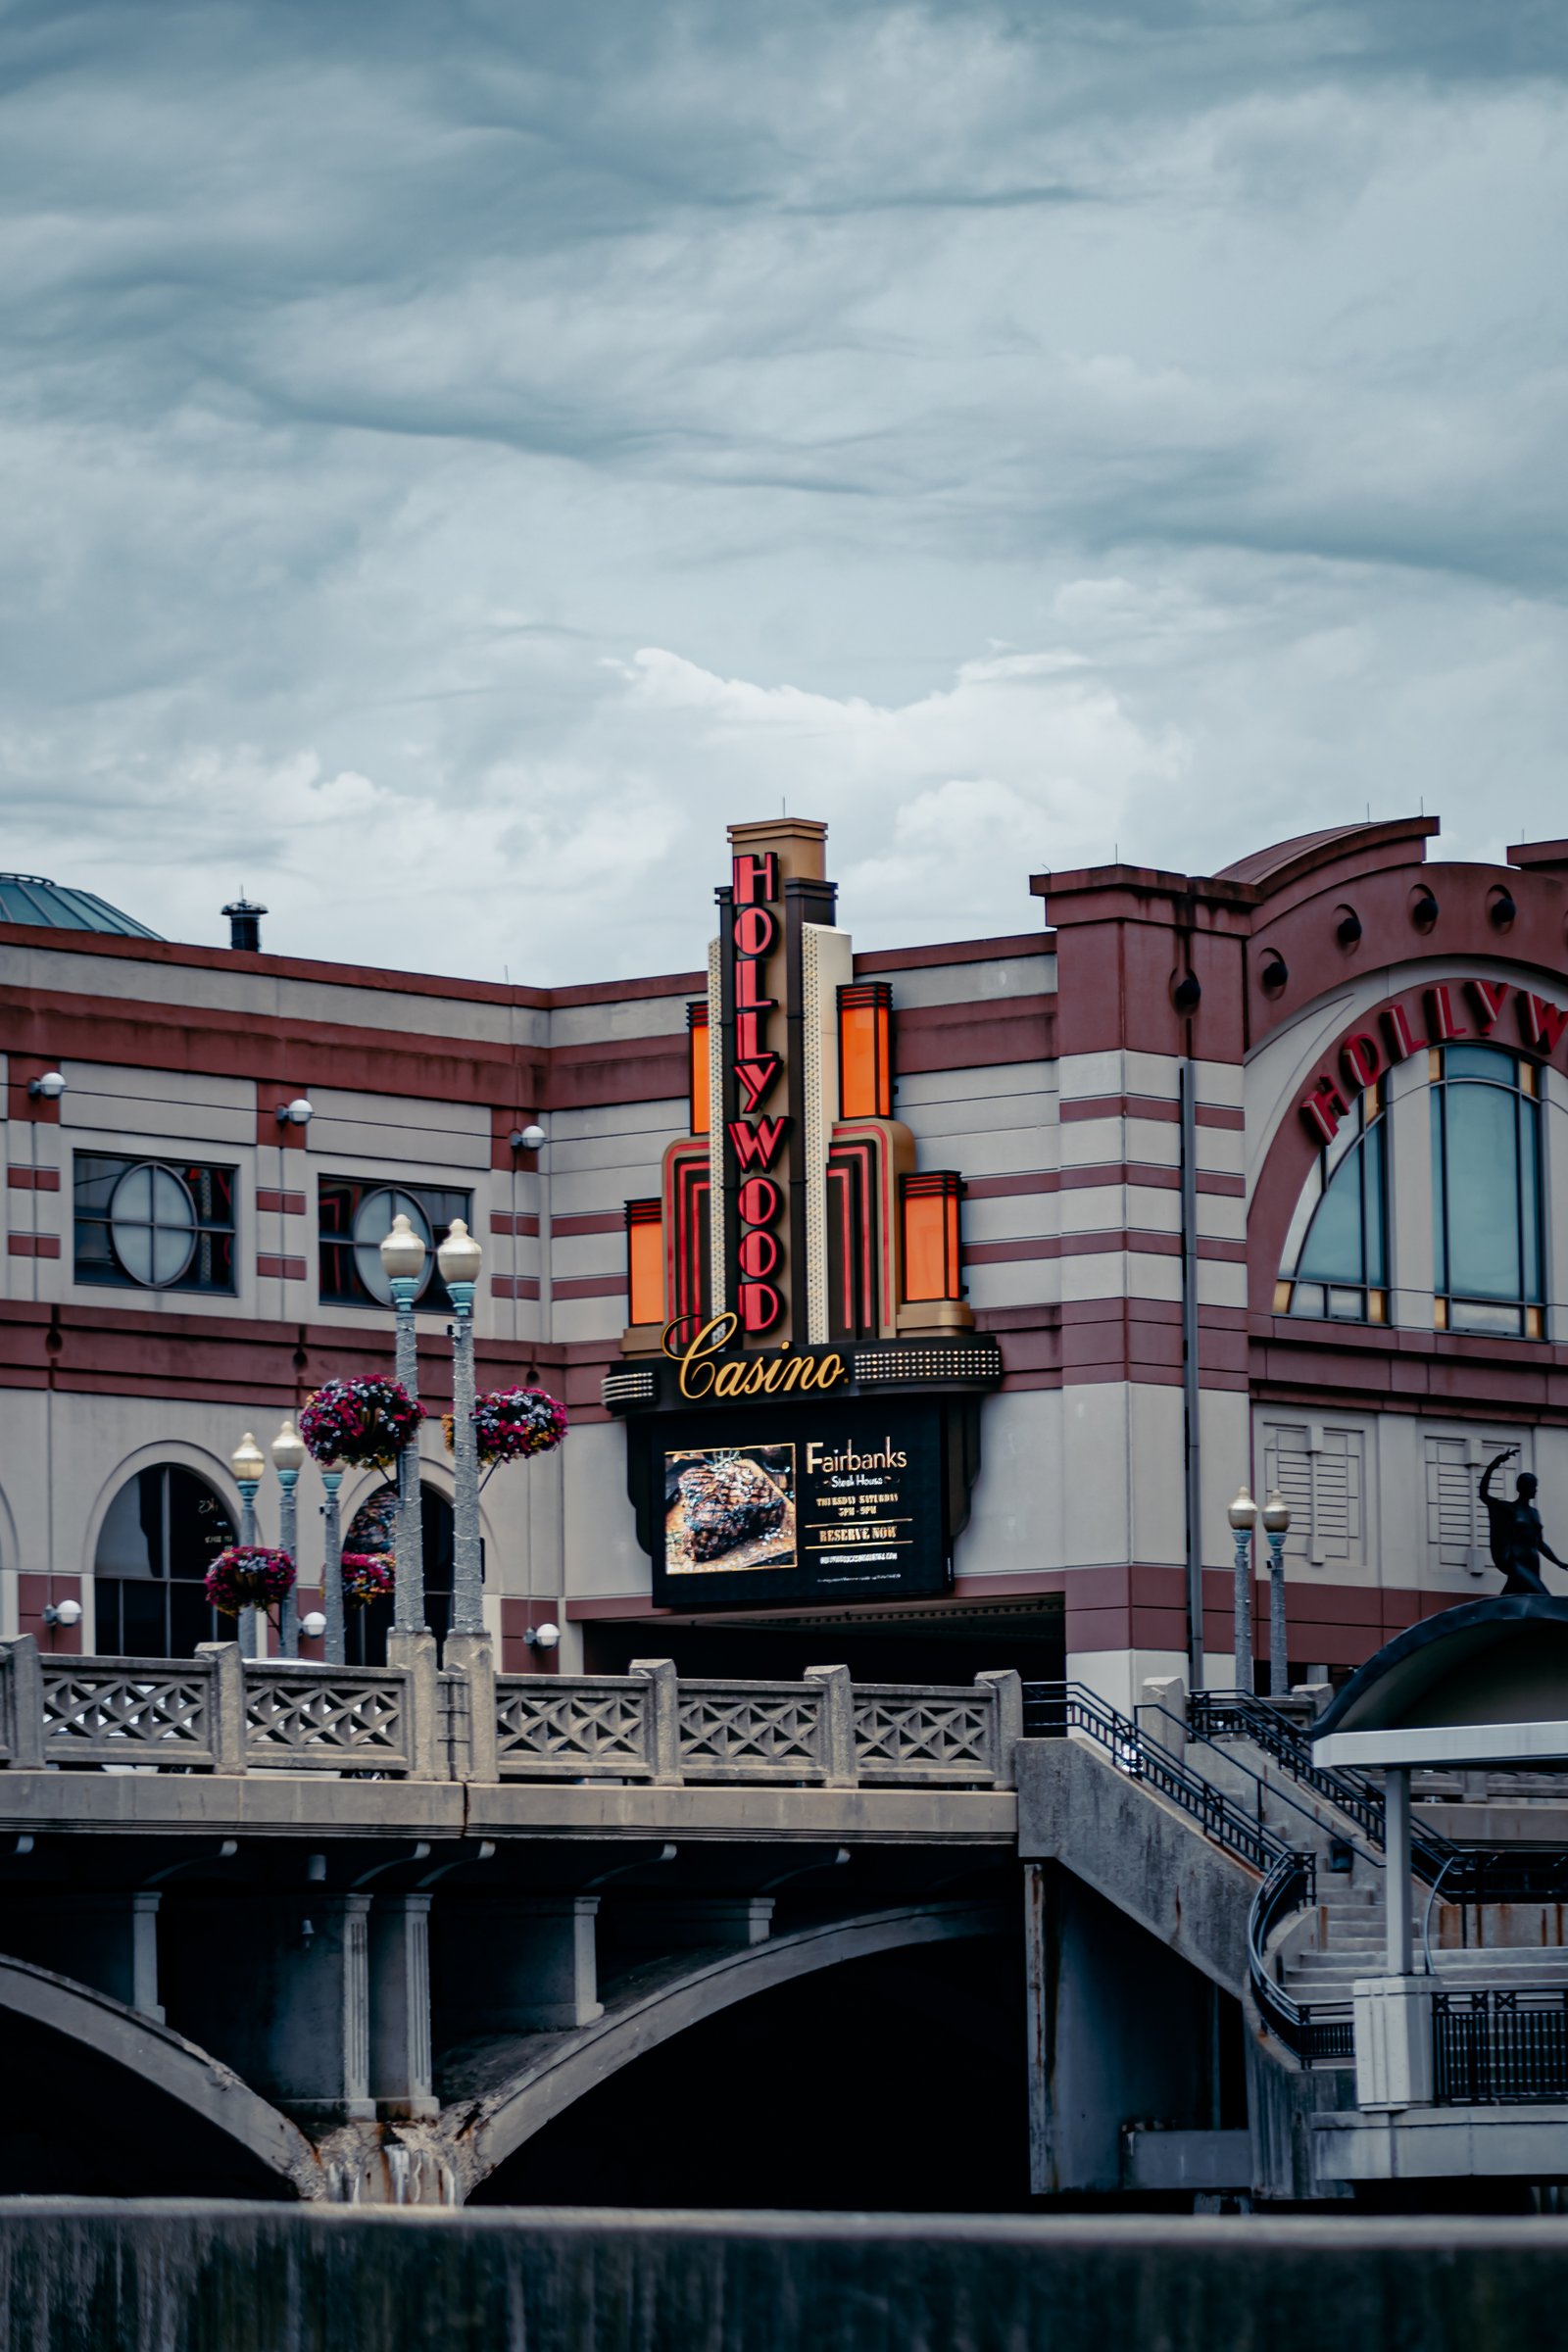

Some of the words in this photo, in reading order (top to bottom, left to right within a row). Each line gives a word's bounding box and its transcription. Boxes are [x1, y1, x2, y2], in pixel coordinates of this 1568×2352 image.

[728, 852, 787, 1332] HOLLYWOOD
[662, 1311, 845, 1399] Casino
[806, 1436, 907, 1474] Fairbanks
[831, 1475, 855, 1488] Steak
[857, 1474, 883, 1486] House
[819, 1528, 870, 1543] RESERVE
